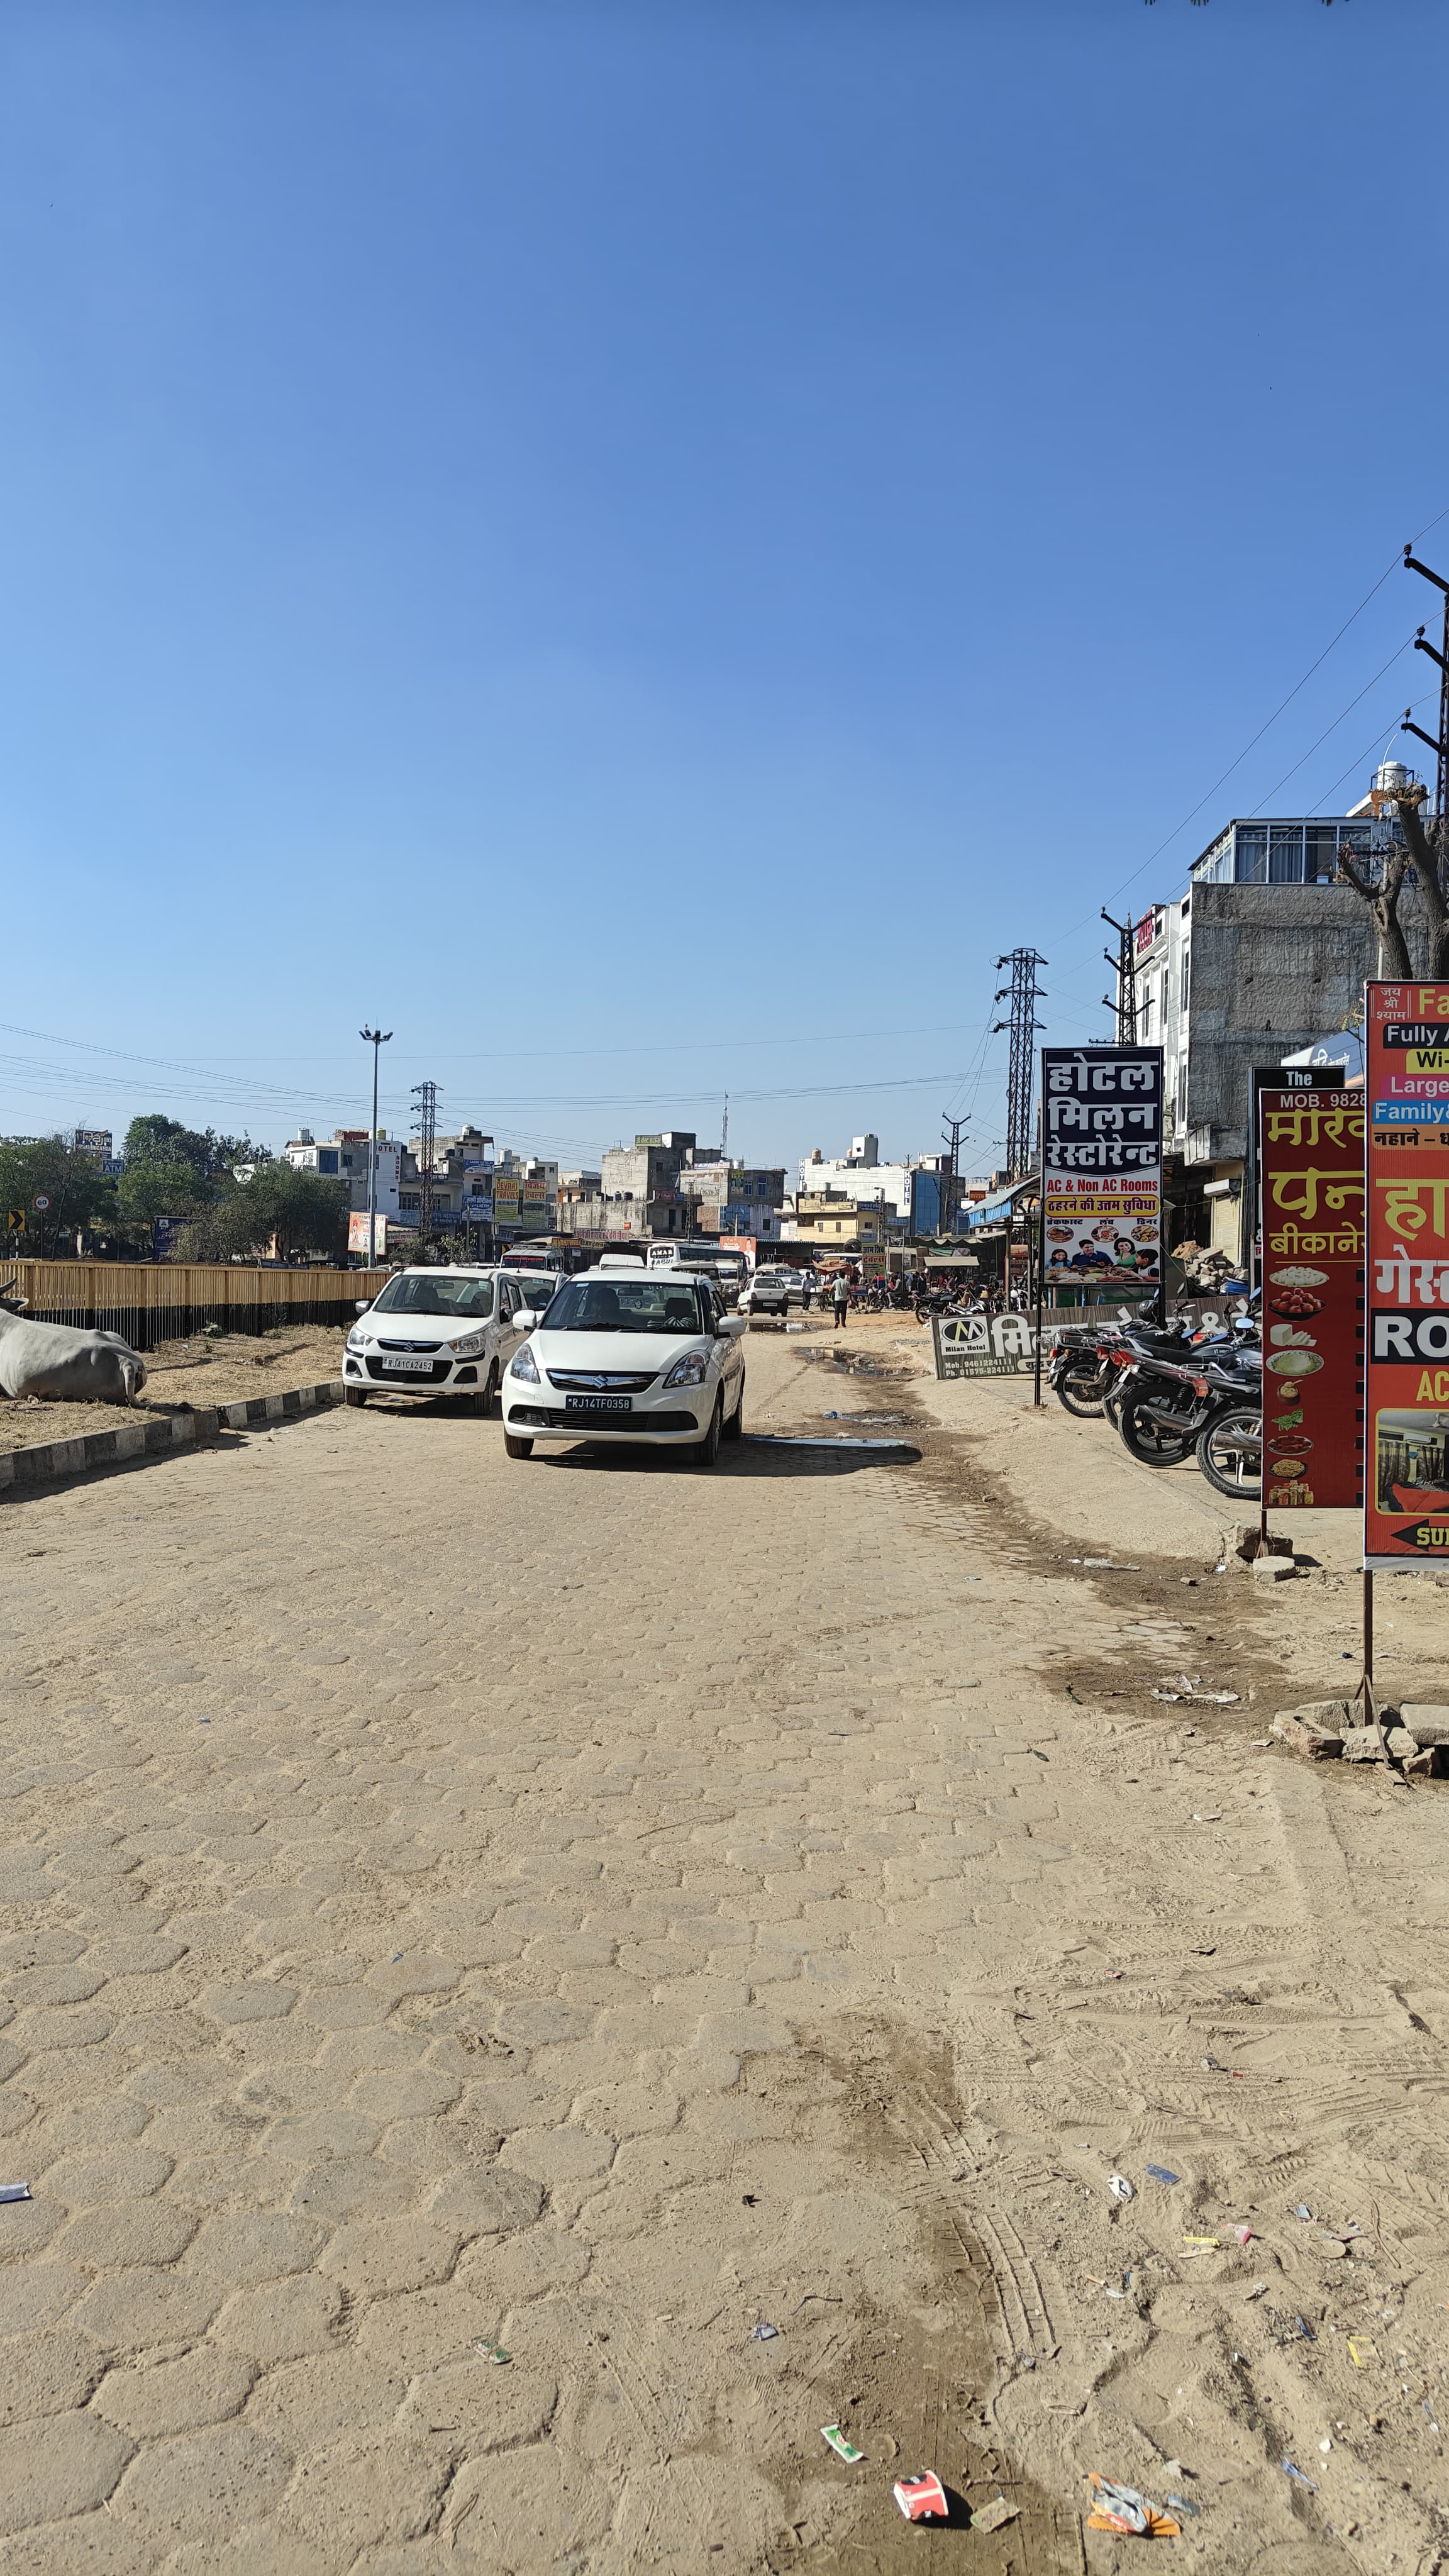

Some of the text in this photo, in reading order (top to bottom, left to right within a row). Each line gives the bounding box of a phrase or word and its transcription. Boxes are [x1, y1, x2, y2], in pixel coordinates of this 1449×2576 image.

[1380, 987, 1402, 997] जय
[1384, 997, 1399, 1009] श्री
[1376, 1011, 1406, 1021] श्याम
[1387, 1025, 1438, 1046] Fully
[1047, 1053, 1158, 1092] होटल
[1286, 1071, 1313, 1086] The
[1391, 1076, 1449, 1097] Large
[1280, 1094, 1324, 1108] MOB.
[1048, 1097, 1158, 1130] मिलन
[1374, 1128, 1420, 1146] नहाने
[1046, 1134, 1158, 1166] रेस्टोरेन्ट
[1047, 1179, 1158, 1192] AC & Non AC Rooms
[1048, 1197, 1156, 1214] ठहरने की उत्तम सुविधा
[1269, 1221, 1365, 1255] बीकाने
[388, 1360, 431, 1370] RJ41CA2452
[572, 1398, 630, 1409] RJ14TF0358
[1417, 1528, 1449, 1545] SU
